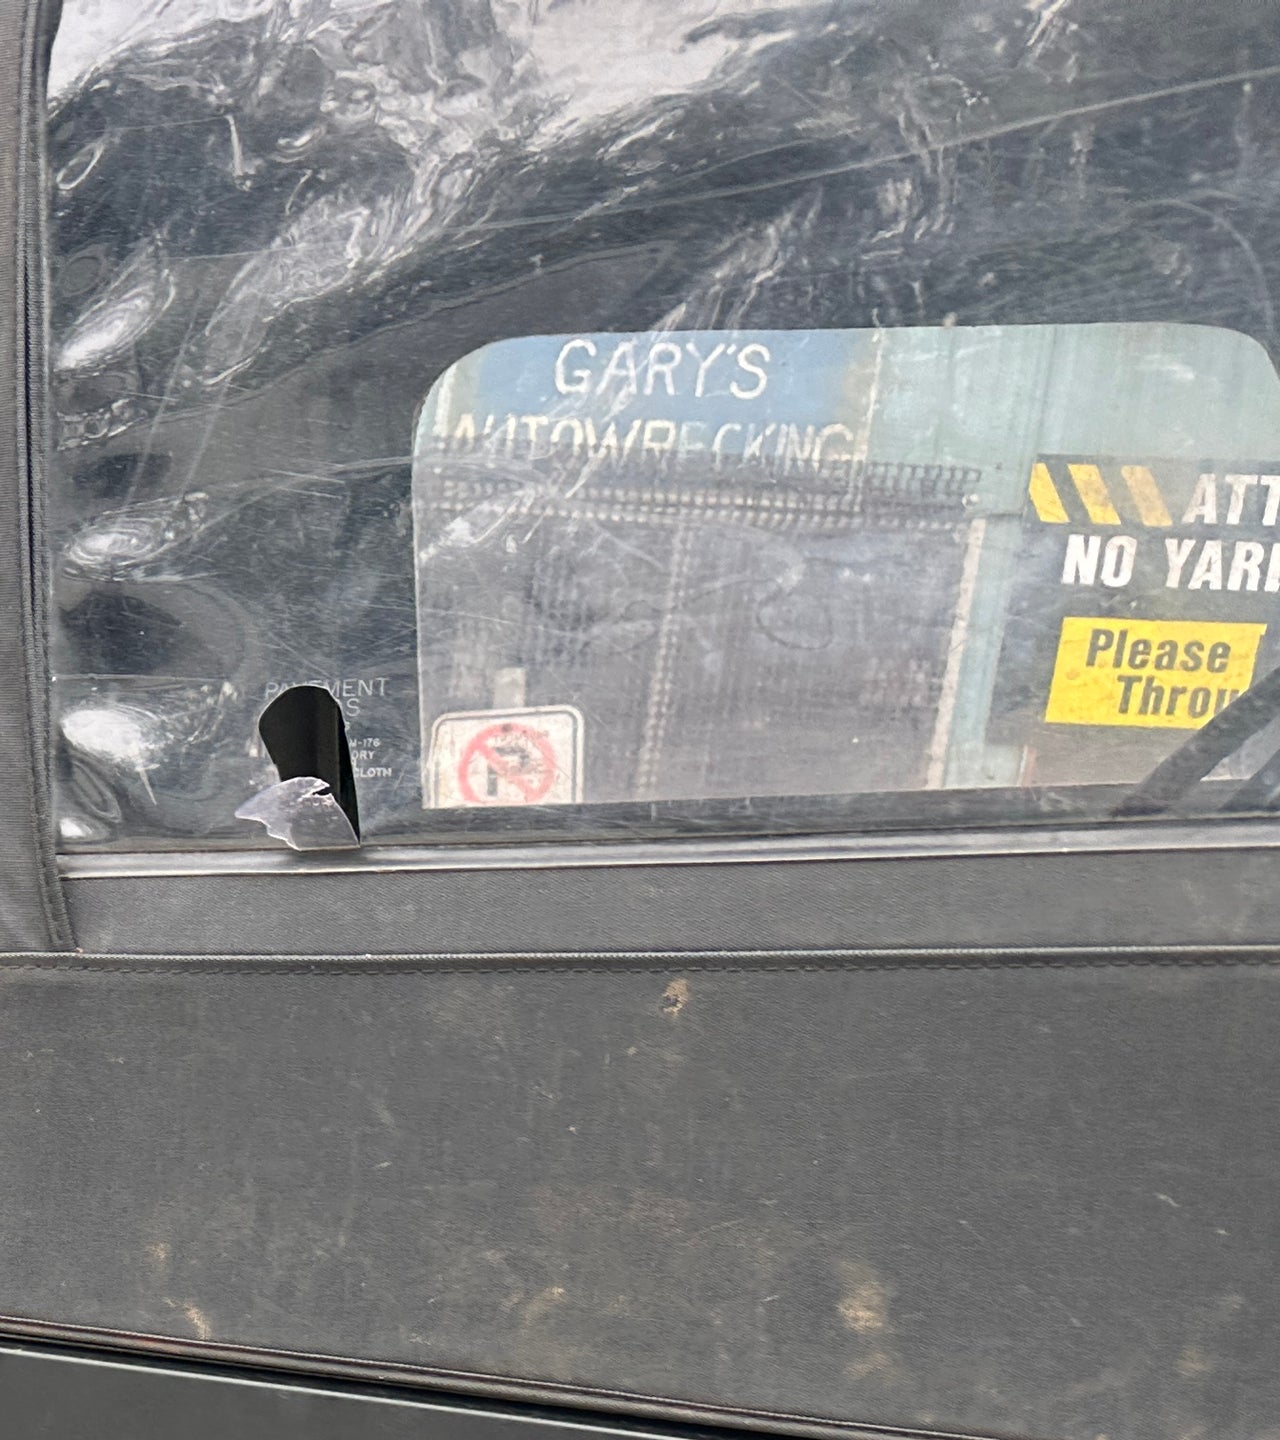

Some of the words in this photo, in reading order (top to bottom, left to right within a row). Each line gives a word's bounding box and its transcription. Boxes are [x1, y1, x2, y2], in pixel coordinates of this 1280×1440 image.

[554, 338, 771, 400] GARY'S
[1060, 533, 1138, 588] NO
[1085, 628, 1232, 674] Please
